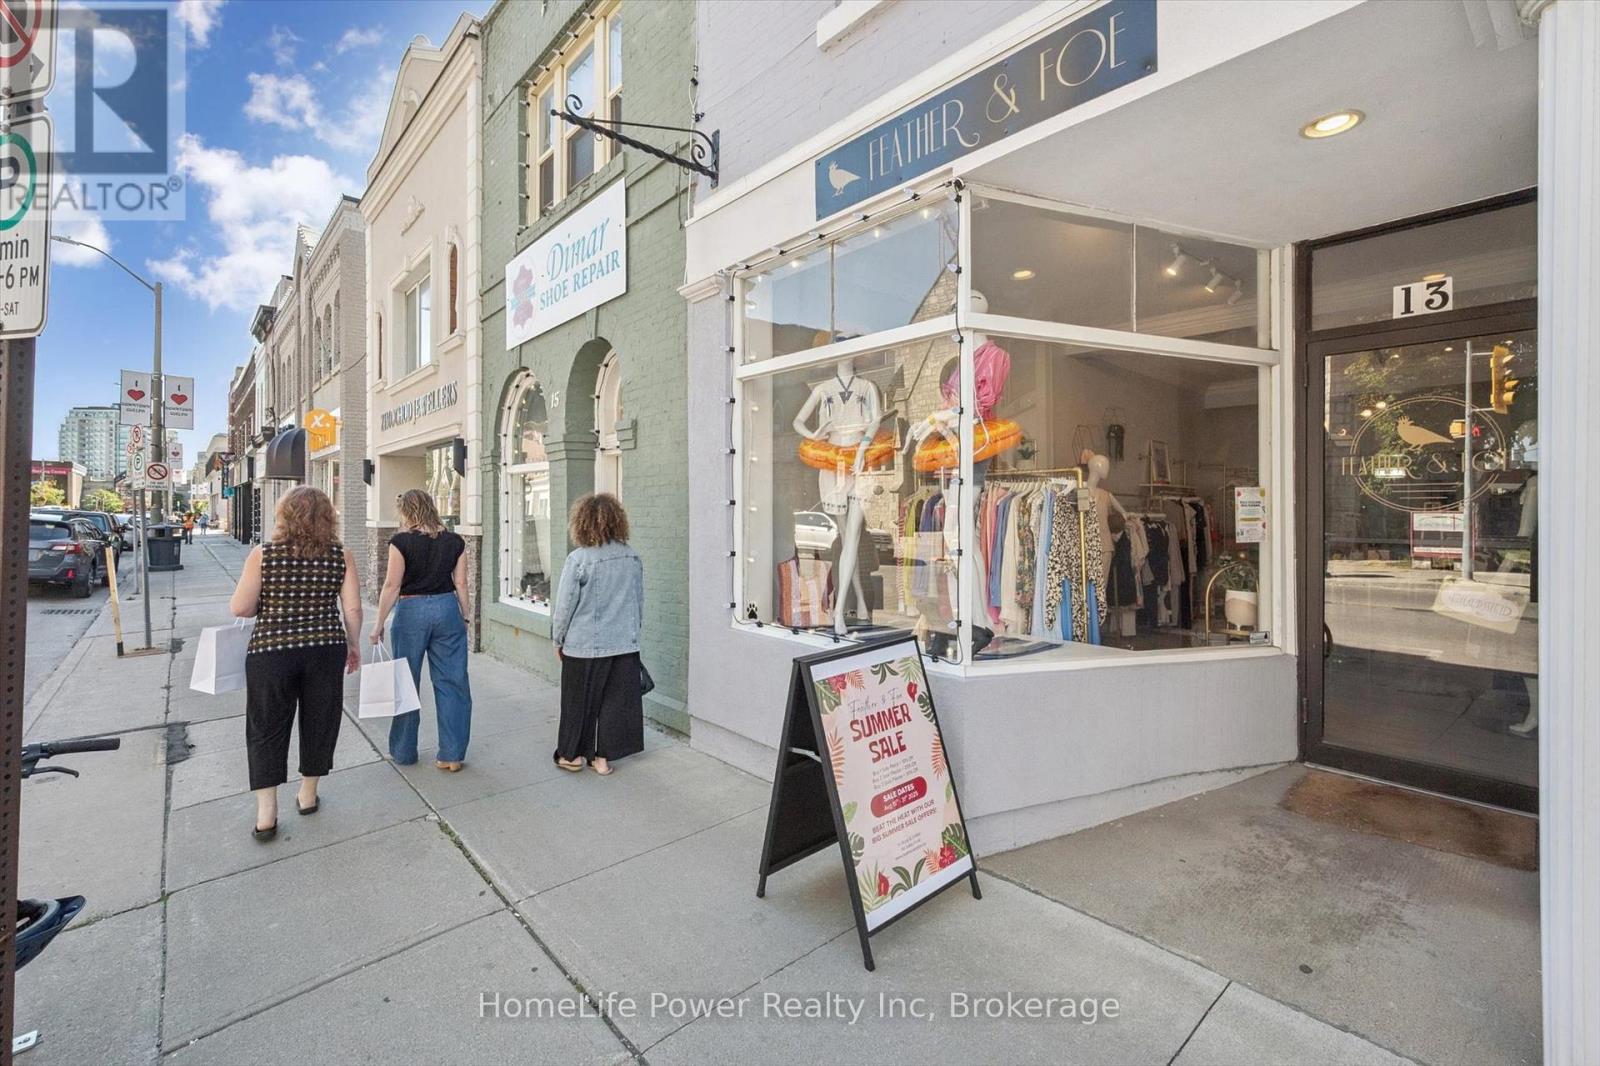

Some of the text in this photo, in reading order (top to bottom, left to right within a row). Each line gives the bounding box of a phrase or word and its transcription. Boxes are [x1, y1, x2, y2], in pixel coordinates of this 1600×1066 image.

[868, 11, 1127, 181] FEATHER & FOE
[0, 233, 29, 260] min
[19, 265, 40, 288] PM
[540, 249, 621, 311] SHOE REPAIR
[1401, 280, 1449, 315] 13
[413, 380, 458, 425] JEWELLERS
[550, 391, 560, 410] 15
[1427, 452, 1449, 474] &
[849, 702, 911, 741] SUMMER
[868, 730, 907, 763] SALE
[882, 782, 914, 802] SALE DATES
[871, 798, 934, 834] BEAT THE HEAT WITH OUR
[881, 823, 904, 839] SUMMER
[904, 817, 916, 827] SALE
